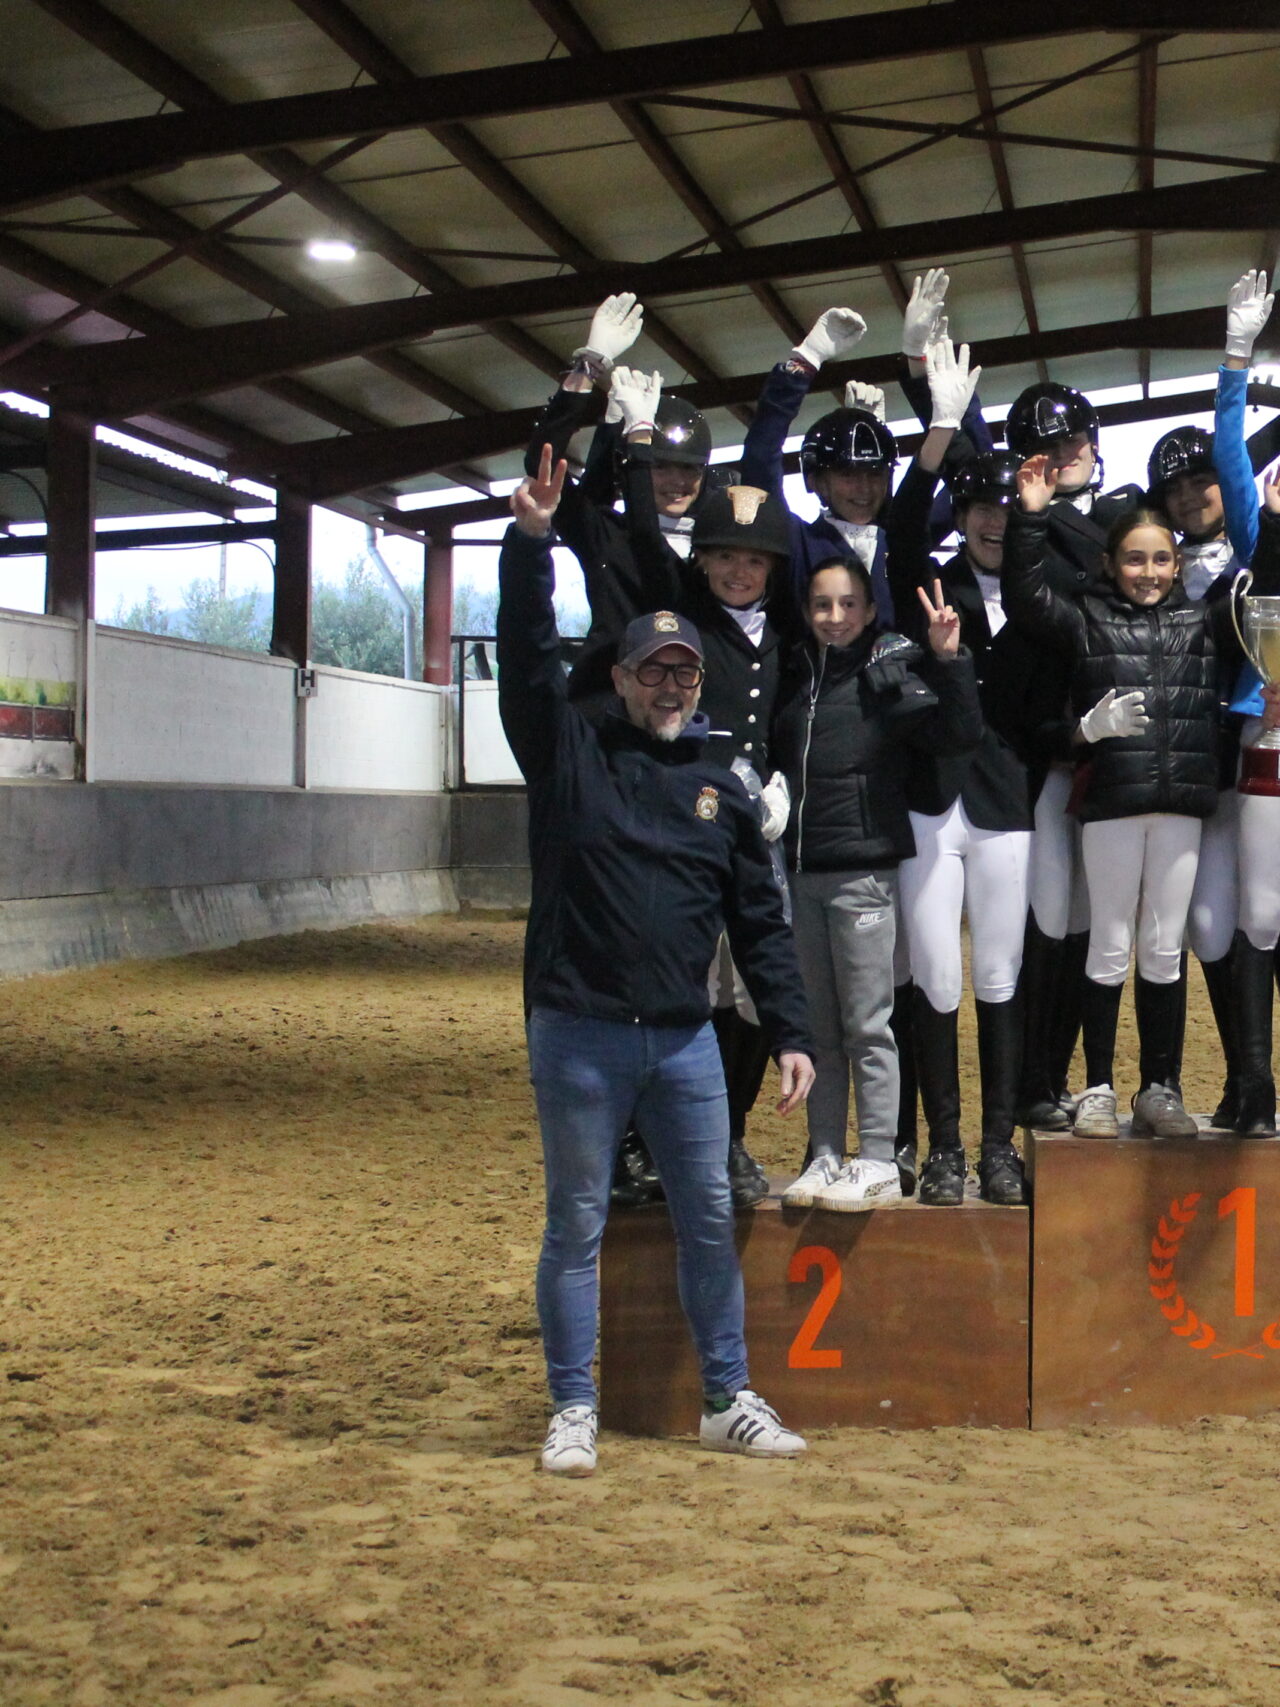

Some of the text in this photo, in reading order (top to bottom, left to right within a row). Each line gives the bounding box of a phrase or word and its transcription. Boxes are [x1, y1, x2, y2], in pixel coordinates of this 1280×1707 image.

[301, 670, 315, 687] H
[859, 912, 881, 924] NIKE
[1217, 1187, 1256, 1317] 1
[788, 1245, 842, 1369] 2
